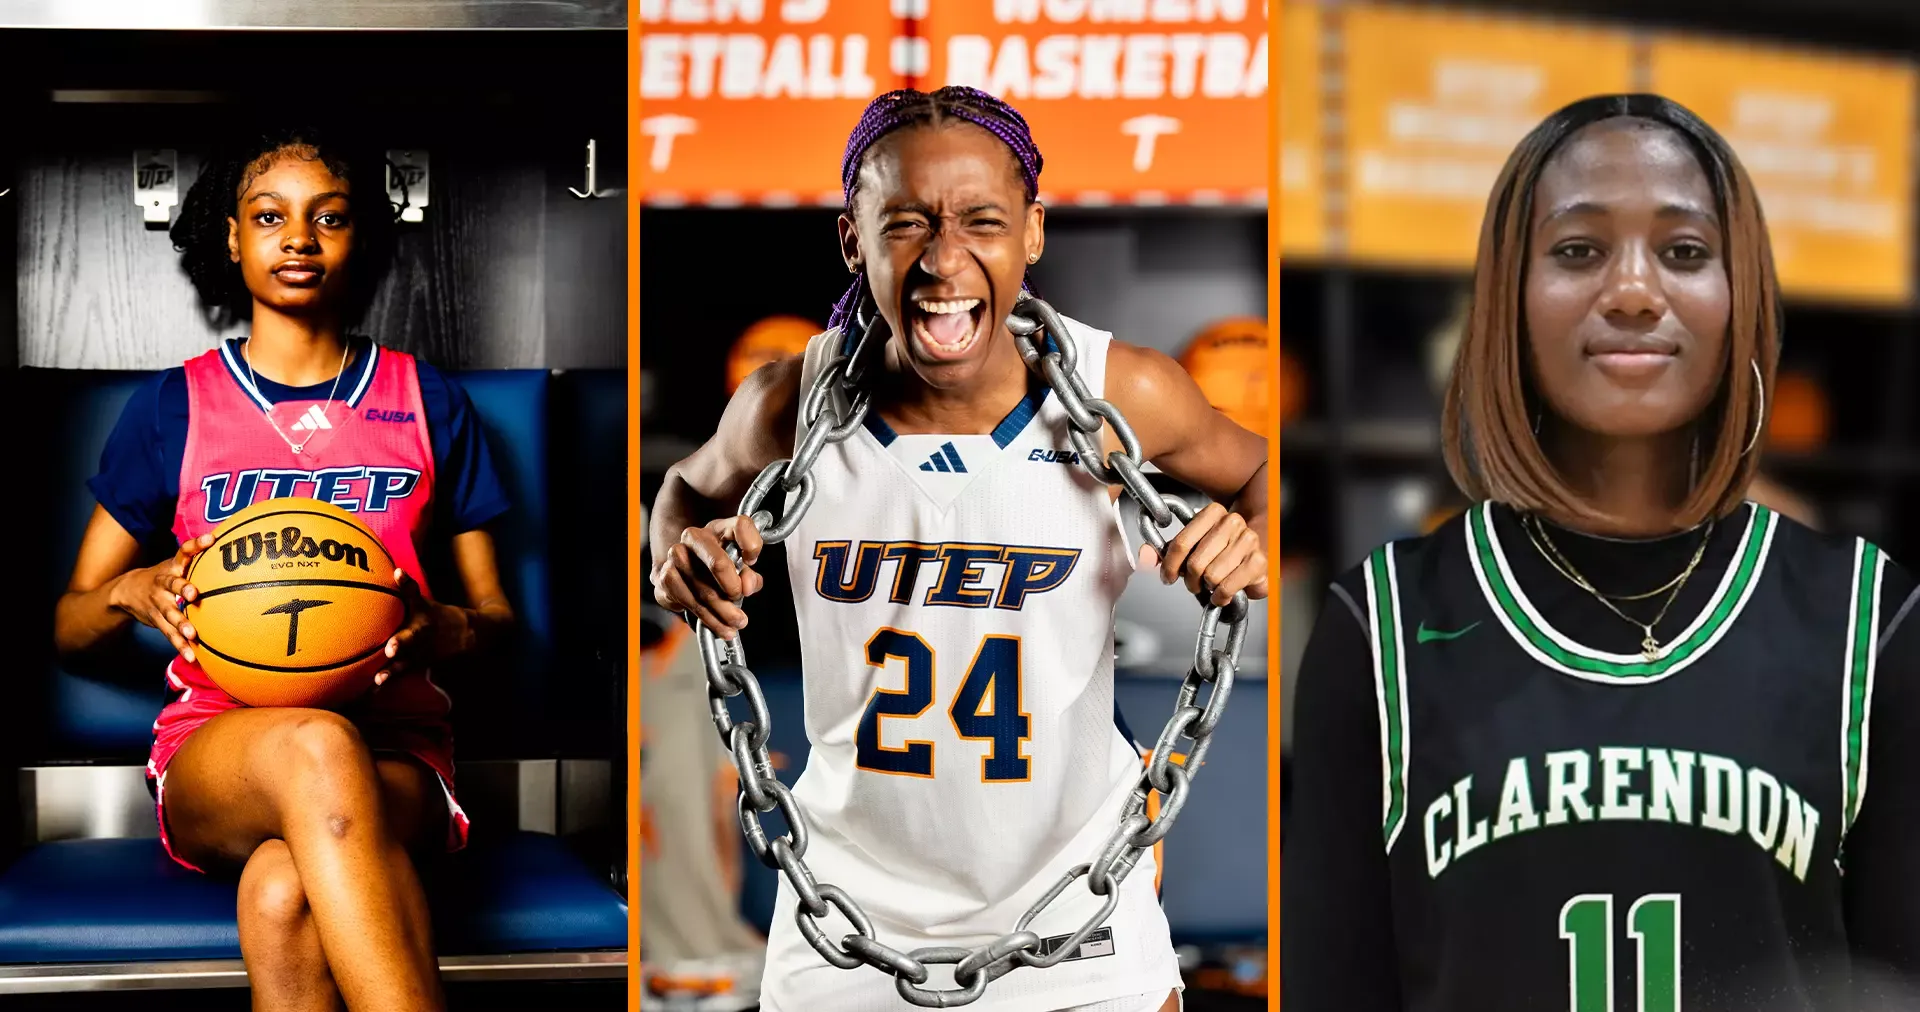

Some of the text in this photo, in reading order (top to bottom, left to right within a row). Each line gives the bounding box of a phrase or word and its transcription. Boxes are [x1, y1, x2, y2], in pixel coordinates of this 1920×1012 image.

[201, 466, 422, 522] UTEP
[219, 527, 370, 572] Wilson
[271, 560, 321, 570] EVO NXT
[812, 540, 1083, 611] UTEP
[854, 626, 1033, 784] 24
[1423, 746, 1821, 884] CLARENDON
[1559, 893, 1682, 1012] 11
